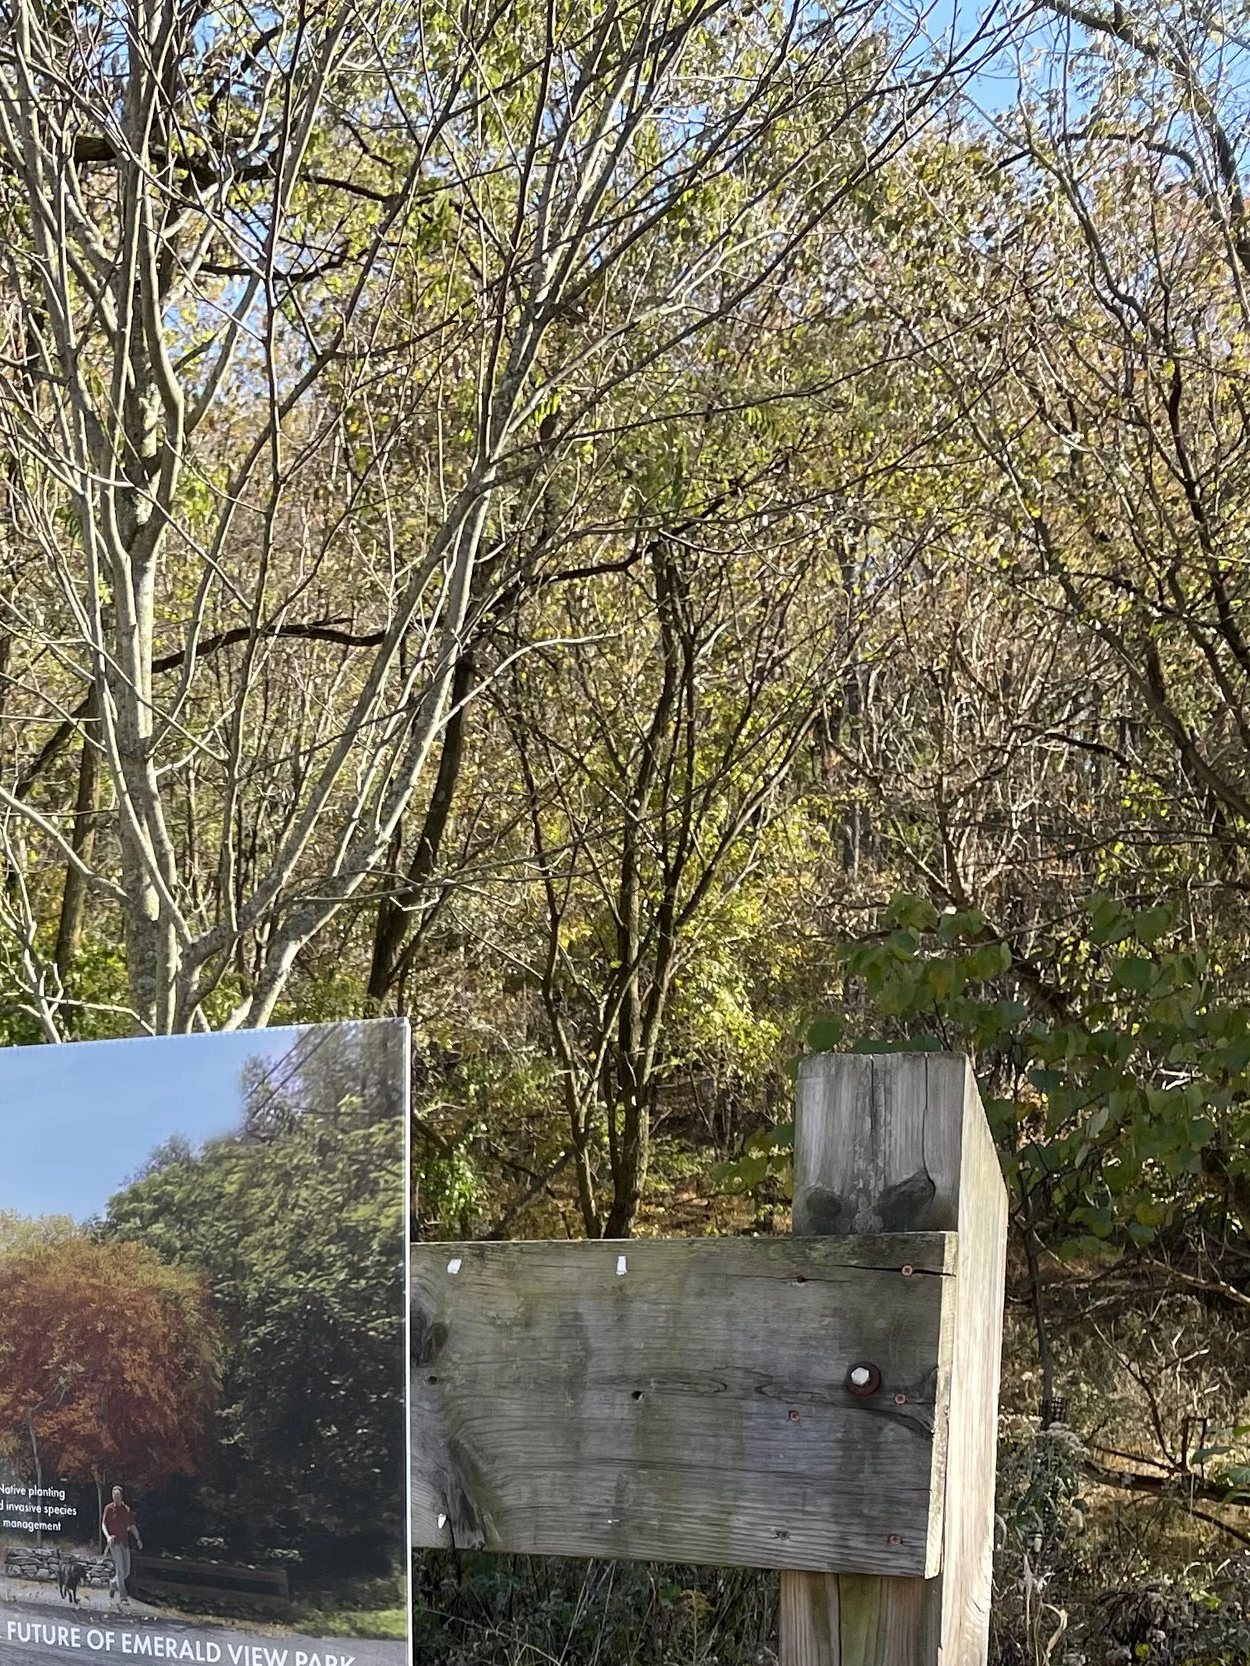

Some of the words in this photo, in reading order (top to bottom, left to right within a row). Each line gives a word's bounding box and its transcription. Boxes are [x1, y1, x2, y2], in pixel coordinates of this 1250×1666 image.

[28, 1486, 66, 1501] planting
[6, 1501, 42, 1514] invasive
[44, 1504, 77, 1519] species
[2, 1518, 62, 1532] management
[6, 1620, 81, 1648] FUTURE
[86, 1628, 115, 1651] OF
[121, 1632, 221, 1662] EMERALD
